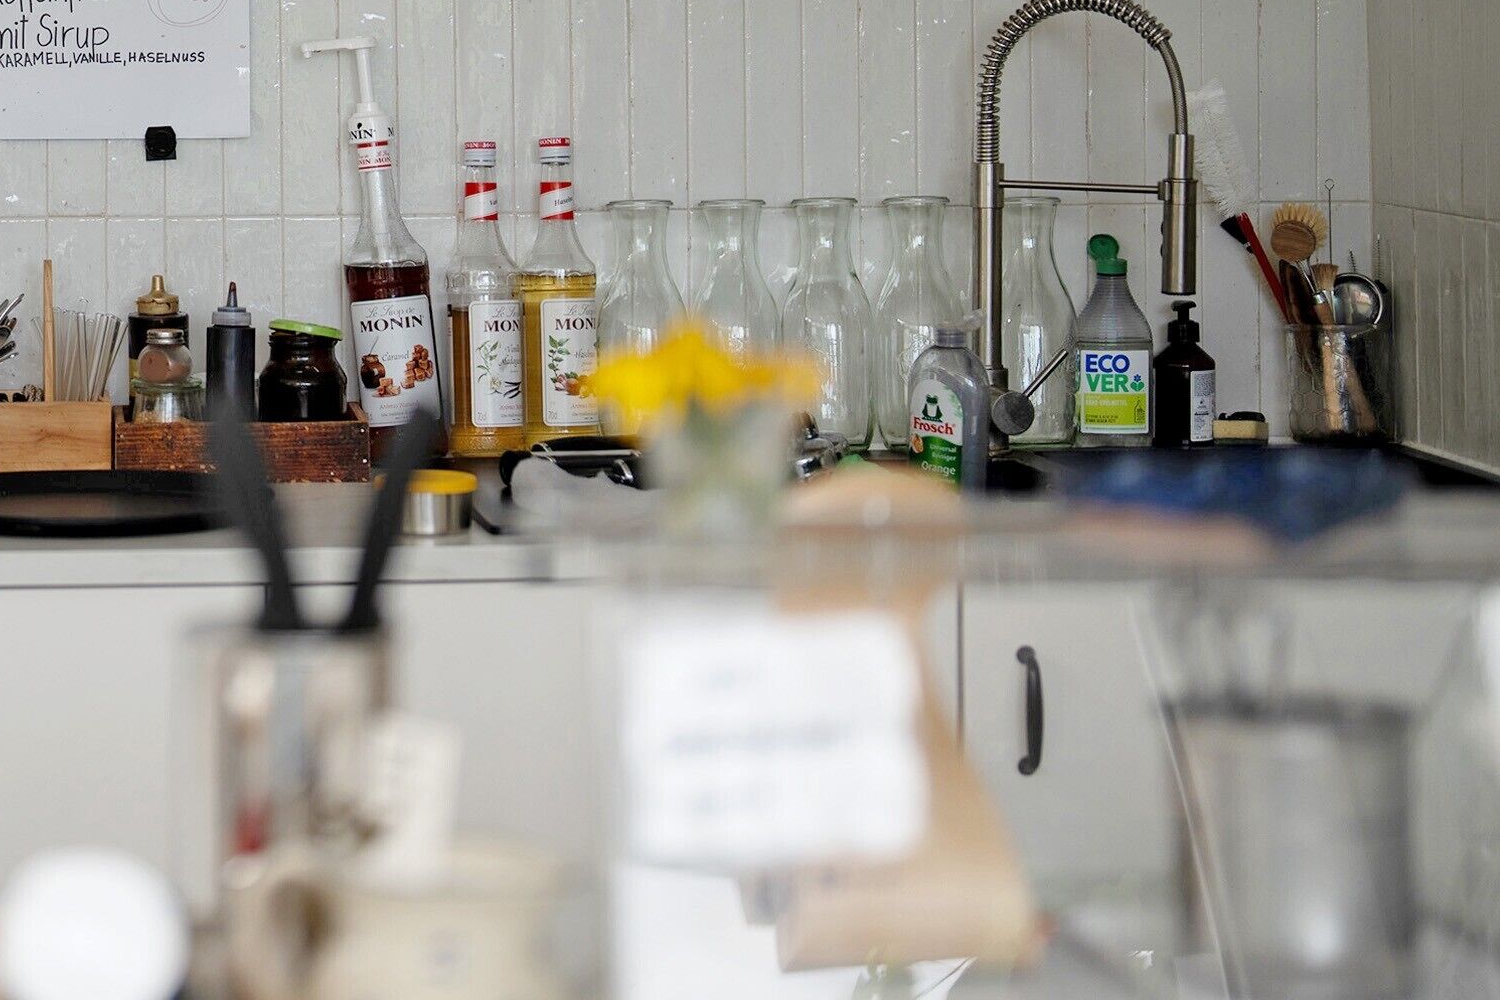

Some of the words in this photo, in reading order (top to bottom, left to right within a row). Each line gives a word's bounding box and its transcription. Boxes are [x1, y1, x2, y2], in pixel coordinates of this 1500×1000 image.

[36, 13, 110, 55] Sirup
[360, 315, 424, 333] MONIN
[484, 319, 521, 333] MON
[555, 317, 596, 331] MON
[1085, 354, 1130, 374] ECO
[1086, 374, 1130, 393] VER
[913, 416, 954, 435] Frosch
[921, 461, 956, 476] Orange
